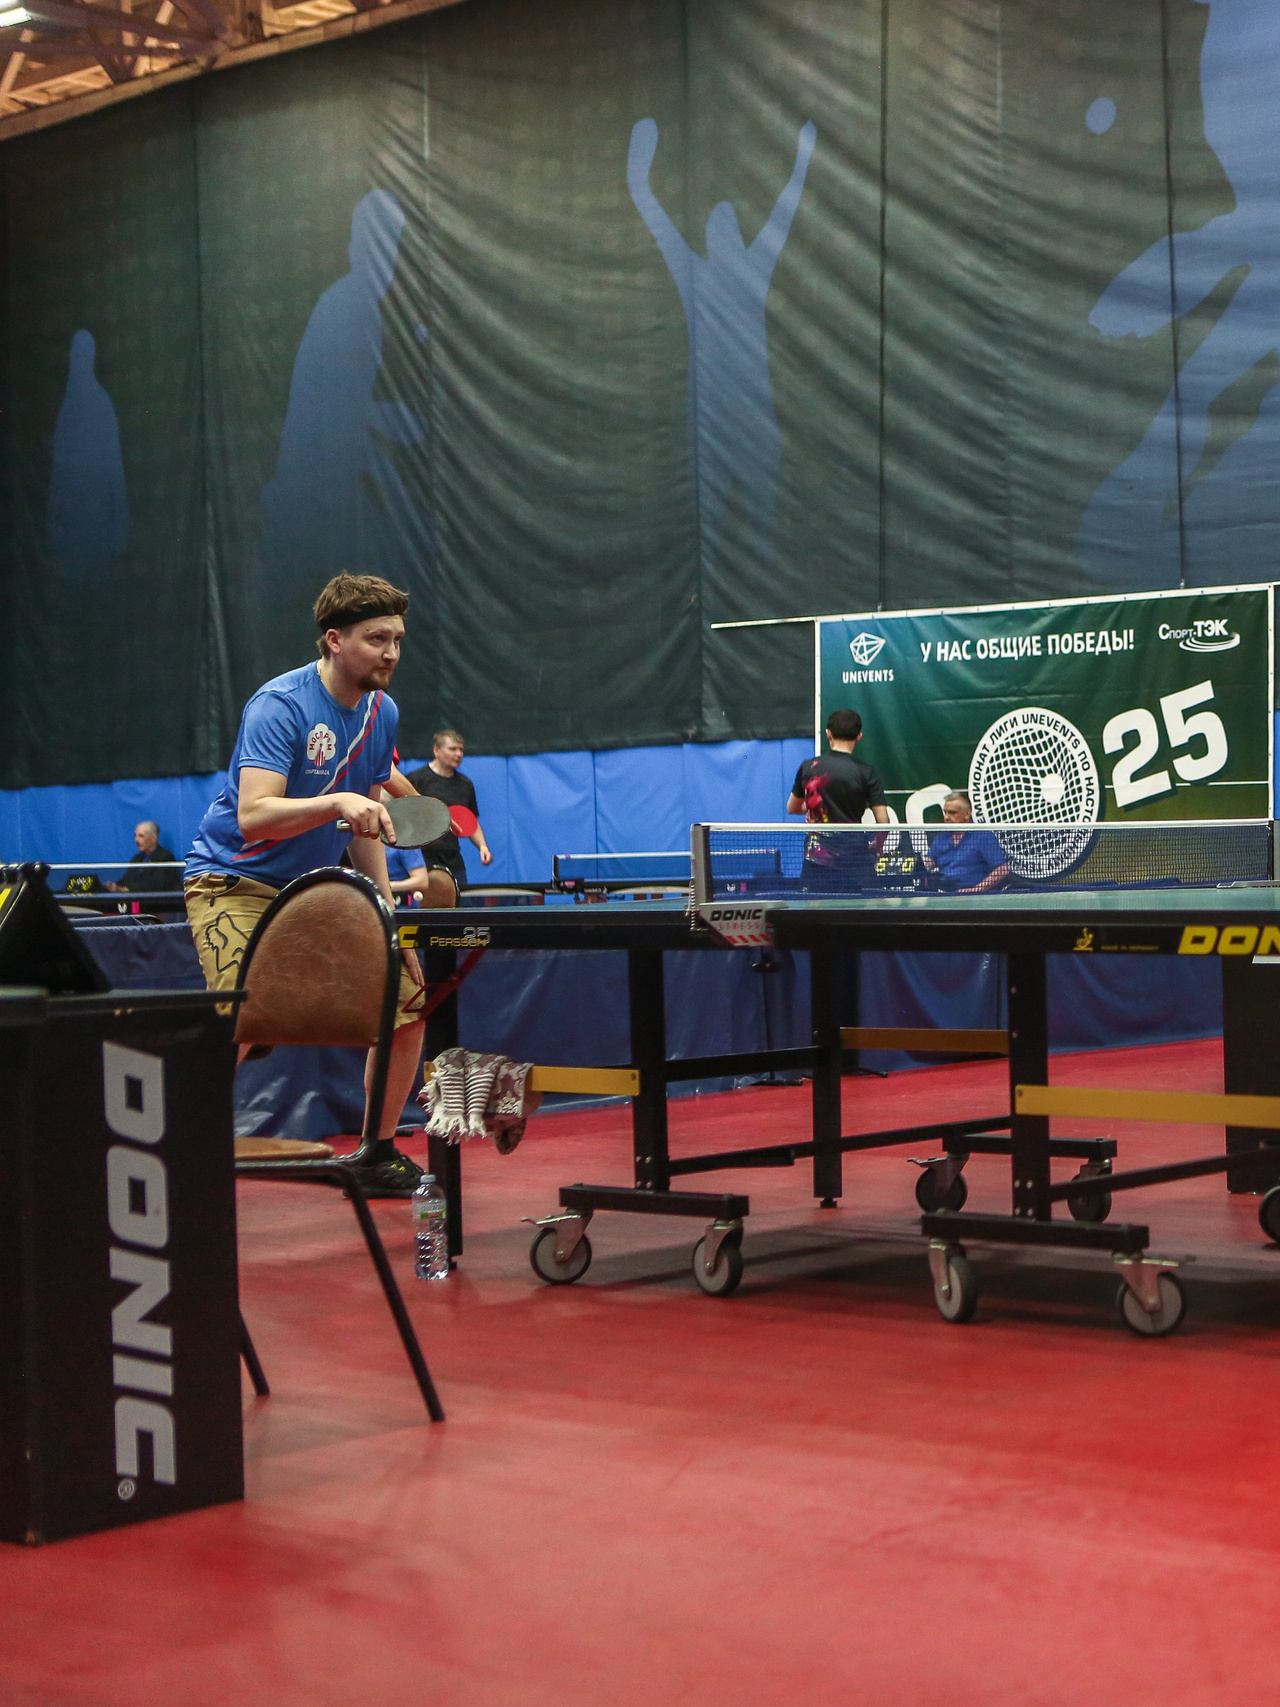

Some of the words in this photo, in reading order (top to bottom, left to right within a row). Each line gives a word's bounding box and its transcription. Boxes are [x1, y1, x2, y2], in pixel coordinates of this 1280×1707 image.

[920, 642, 932, 662] У
[936, 640, 971, 662] НАС
[976, 635, 1042, 660] ОБЩИЕ
[1047, 629, 1135, 656] ПОБЕДЫ!
[842, 669, 895, 684] UNEVENTS
[1102, 679, 1229, 808] 25
[972, 743, 991, 824] ЕМПИОНАТ
[989, 717, 1019, 745] ЛИГИ
[1021, 713, 1081, 750] UNEVENTS
[1078, 750, 1091, 772] ПО
[710, 909, 763, 921] DONIC
[718, 922, 761, 931] STRESS
[102, 1040, 177, 1486] DONIC
